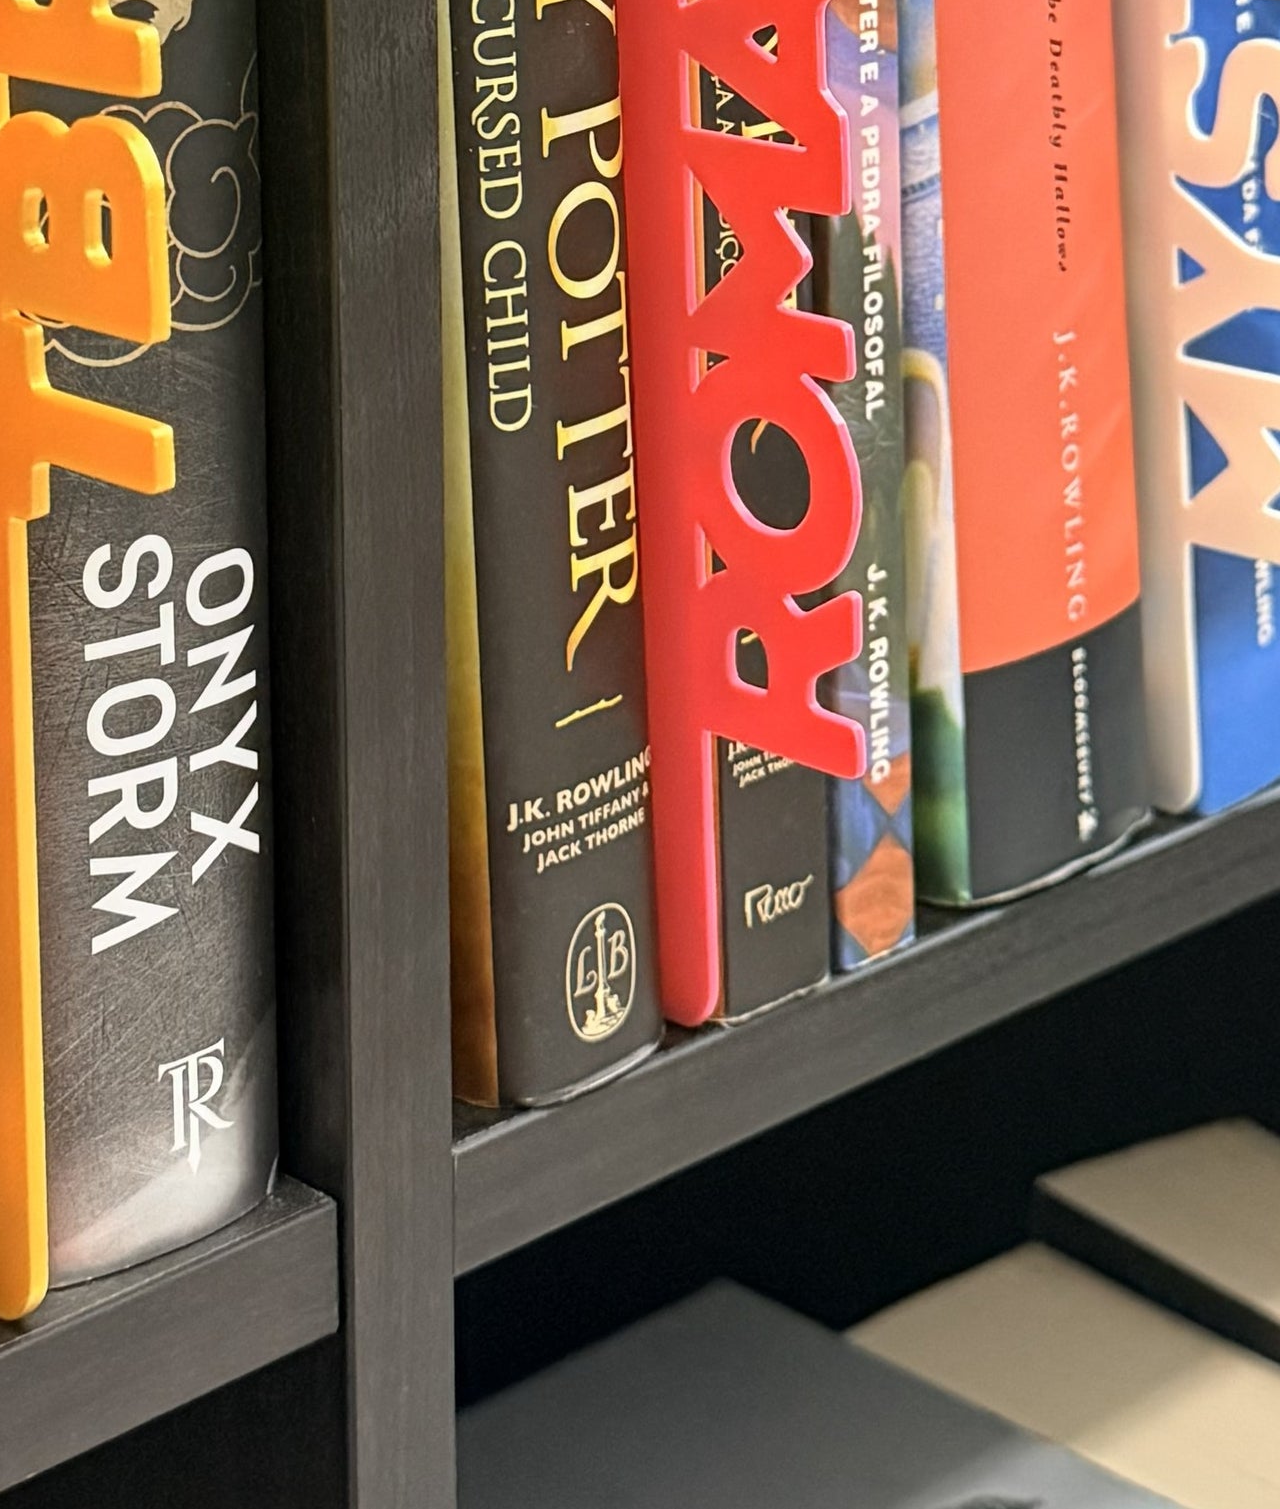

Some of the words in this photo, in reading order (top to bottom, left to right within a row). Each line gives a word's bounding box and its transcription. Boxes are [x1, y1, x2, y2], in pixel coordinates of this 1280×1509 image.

[859, 61, 880, 84] E
[861, 94, 880, 117] A
[1048, 37, 1068, 149] Deathly
[860, 125, 882, 237] PEDRA
[482, 240, 534, 433] CHILD
[540, 92, 642, 672] POTTER
[862, 242, 885, 421] FILOSOFAL
[84, 534, 181, 956] STORM
[186, 545, 261, 886] ONYX
[868, 636, 891, 785] ROWLING
[1071, 645, 1095, 805] BLOOMSBURY
[507, 797, 551, 832] J.K.
[523, 819, 574, 853] JOHN
[578, 787, 640, 829] TIFFANY
[536, 840, 582, 874] JACK
[585, 807, 645, 850] THORNE
